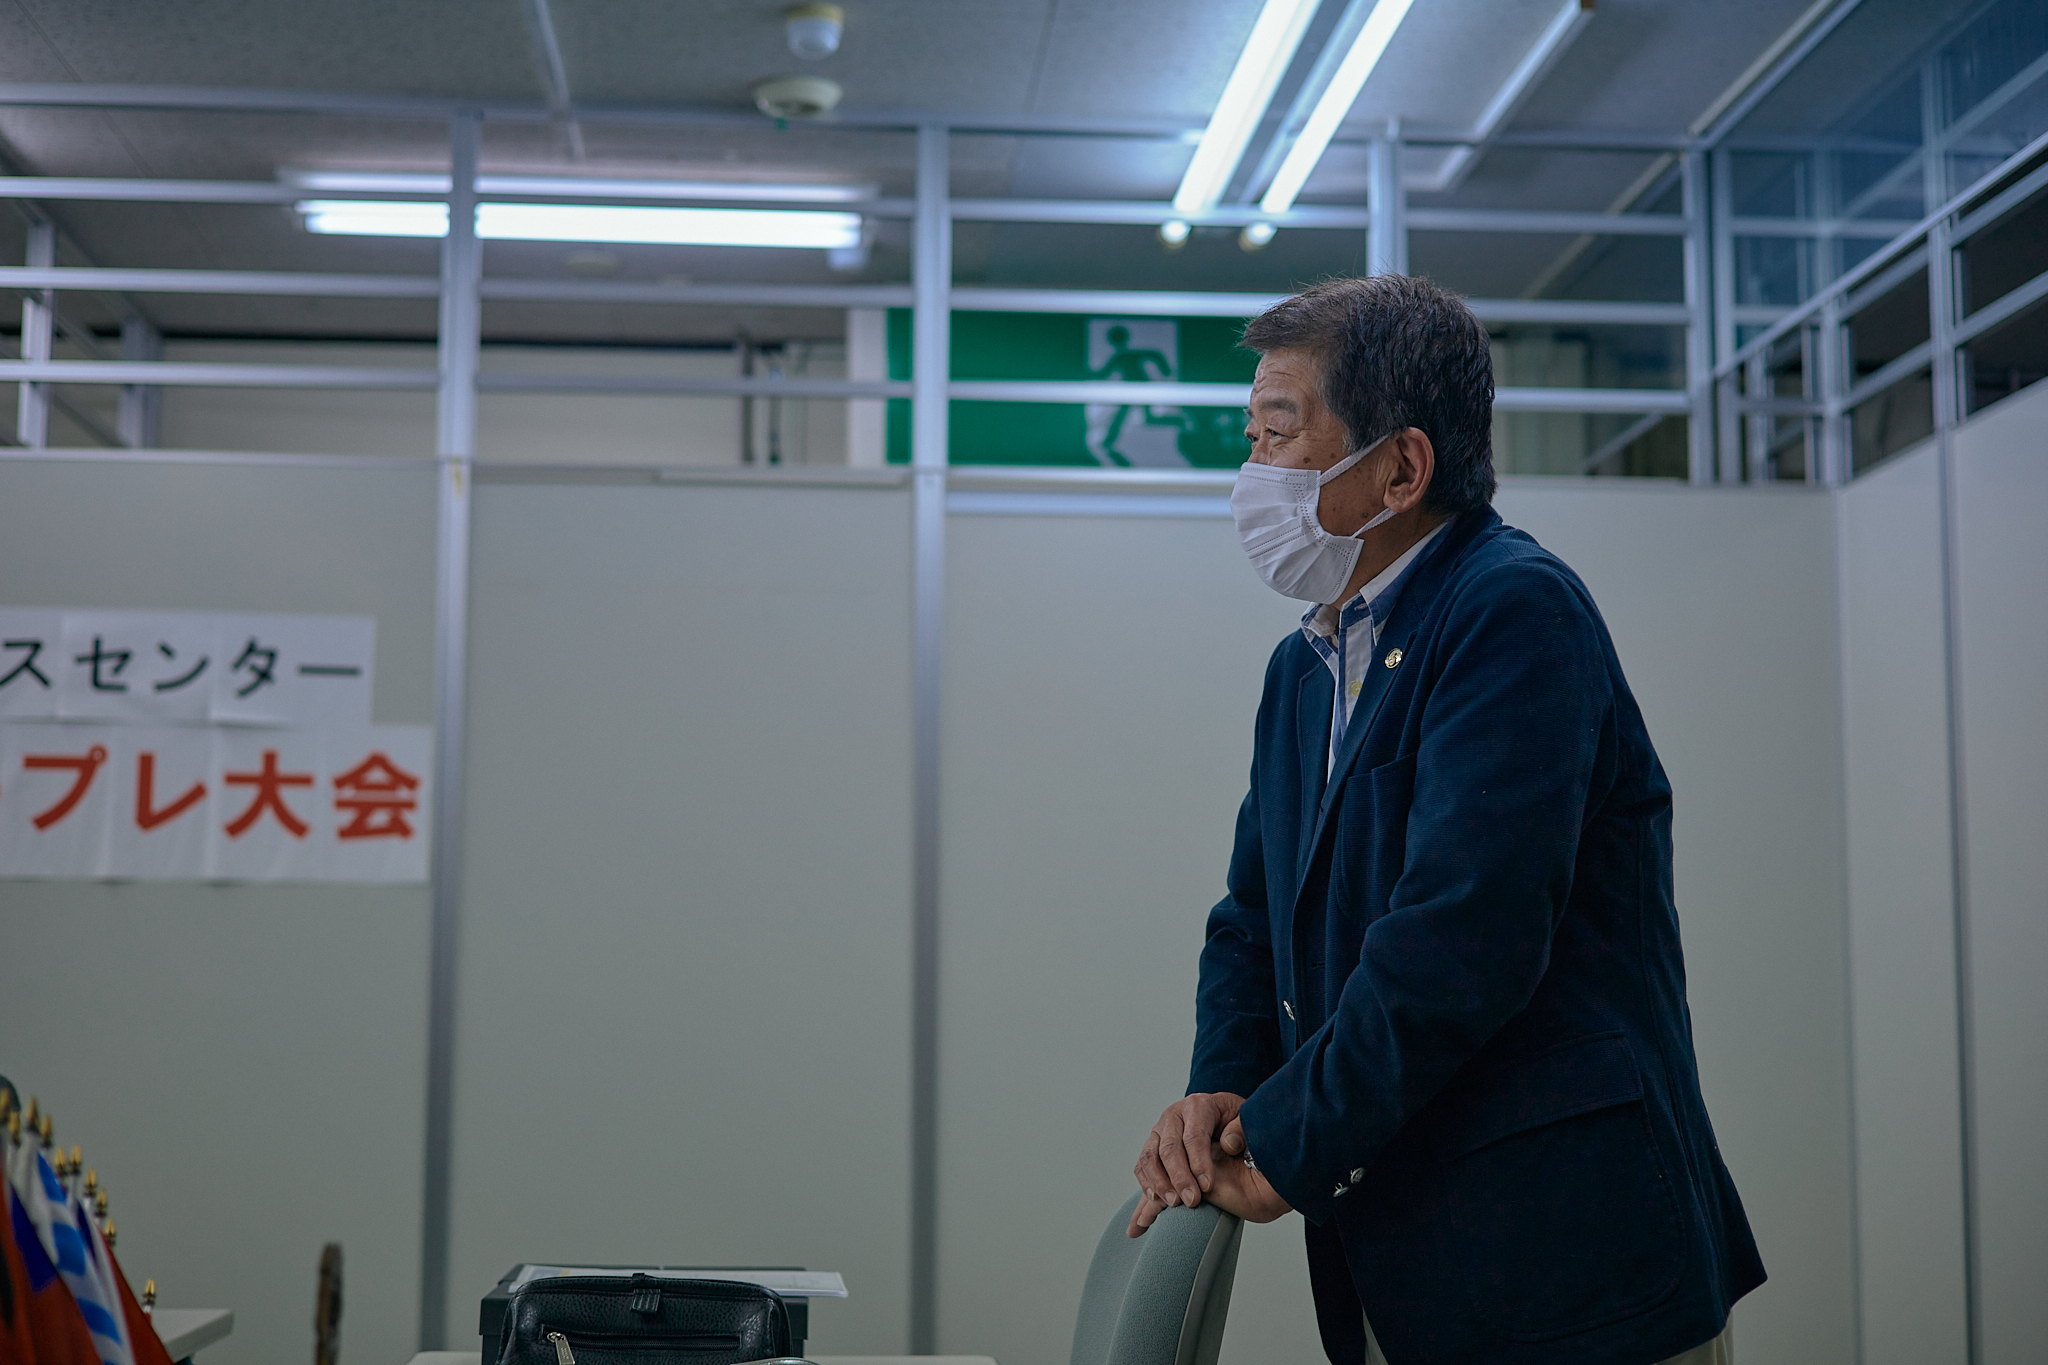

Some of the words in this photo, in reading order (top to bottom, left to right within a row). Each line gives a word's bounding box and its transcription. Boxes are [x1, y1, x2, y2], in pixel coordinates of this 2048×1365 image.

[0, 635, 362, 698] スセンター
[22, 743, 420, 841] プレ大会
